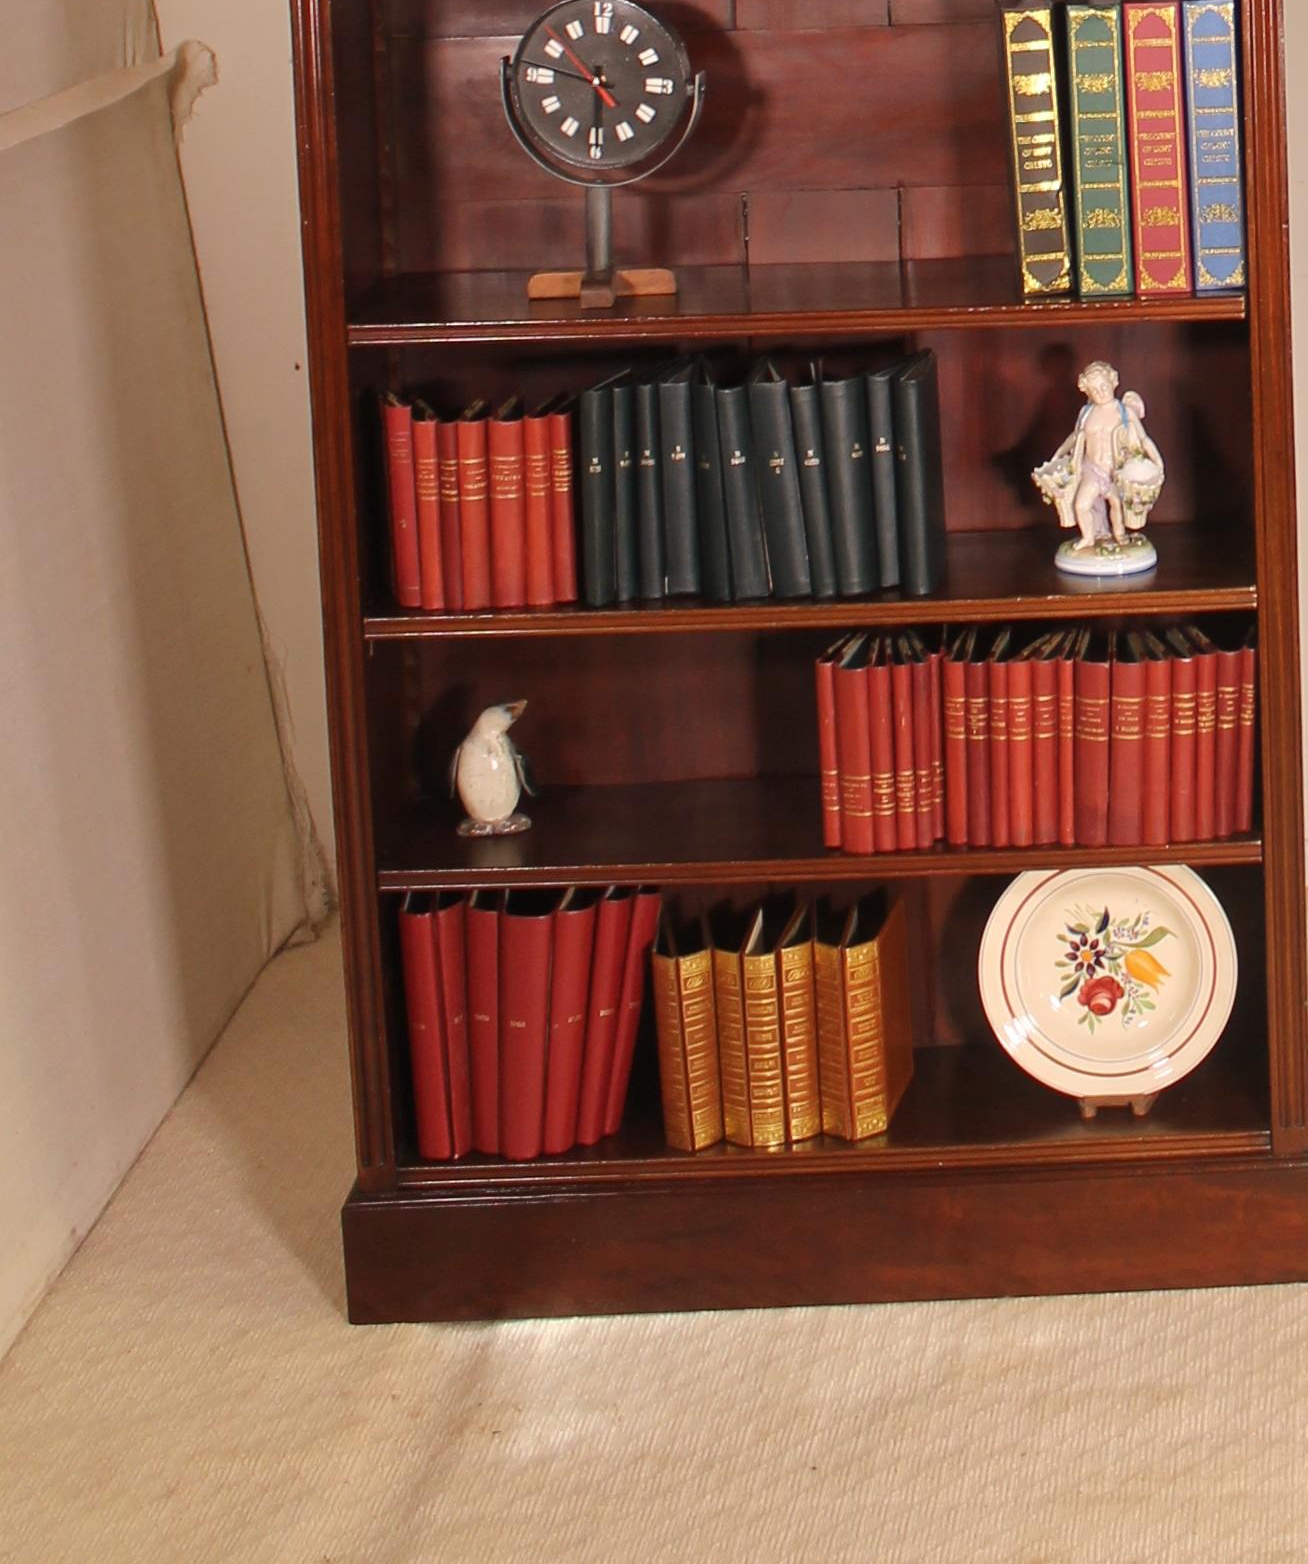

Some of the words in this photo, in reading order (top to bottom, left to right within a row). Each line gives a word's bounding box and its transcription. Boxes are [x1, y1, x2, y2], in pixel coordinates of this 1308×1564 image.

[594, 1, 614, 17] 12
[526, 67, 537, 83] 9
[661, 79, 673, 95] 3
[589, 145, 601, 159] 6
